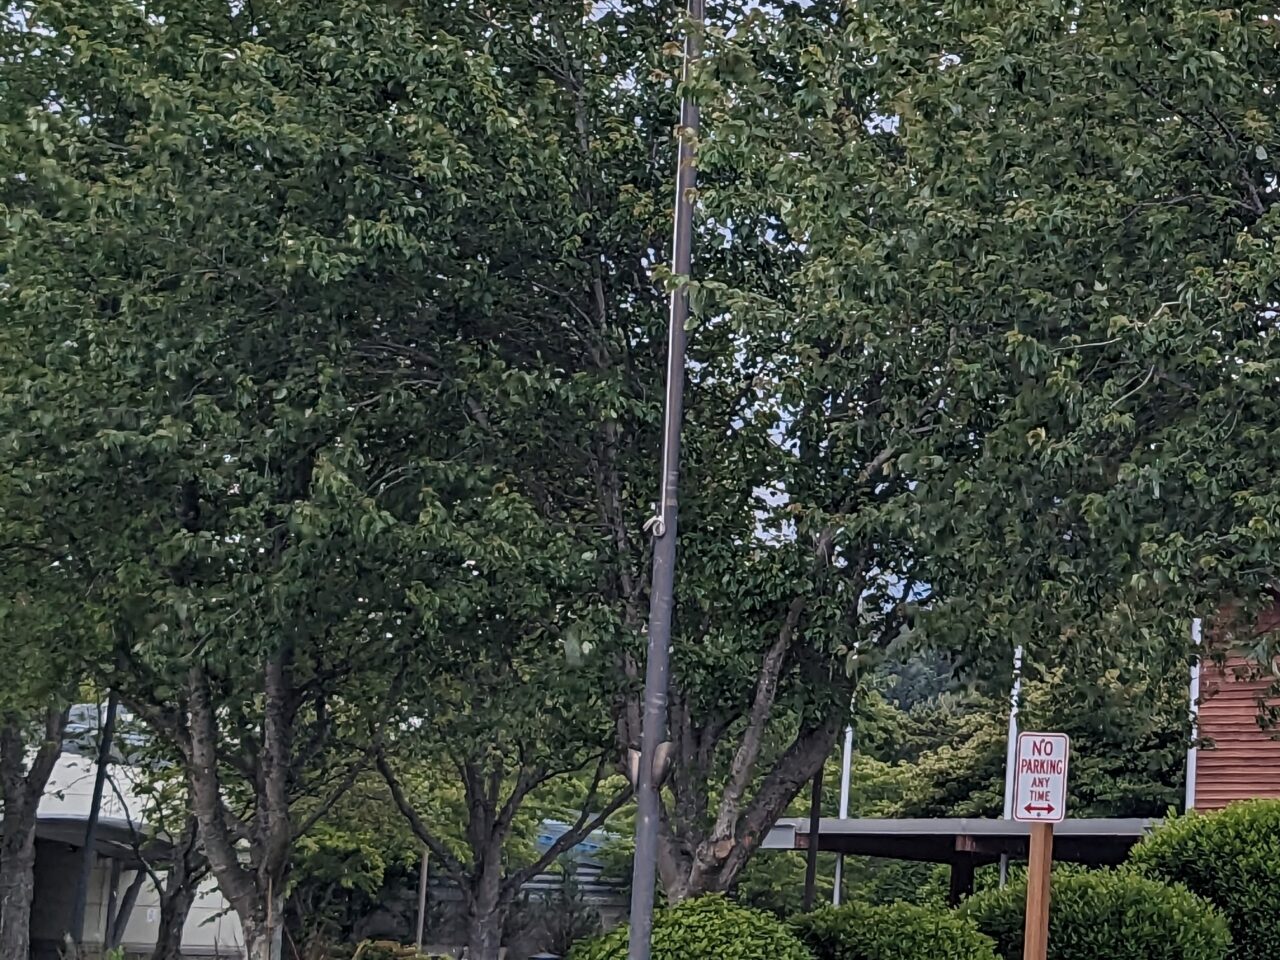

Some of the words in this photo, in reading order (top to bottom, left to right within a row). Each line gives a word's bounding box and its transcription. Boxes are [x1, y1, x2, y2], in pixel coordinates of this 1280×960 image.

[1032, 740, 1053, 756] NO
[1021, 759, 1063, 775] PARKING
[1031, 777, 1050, 788] ANY
[1030, 791, 1050, 802] TIME
